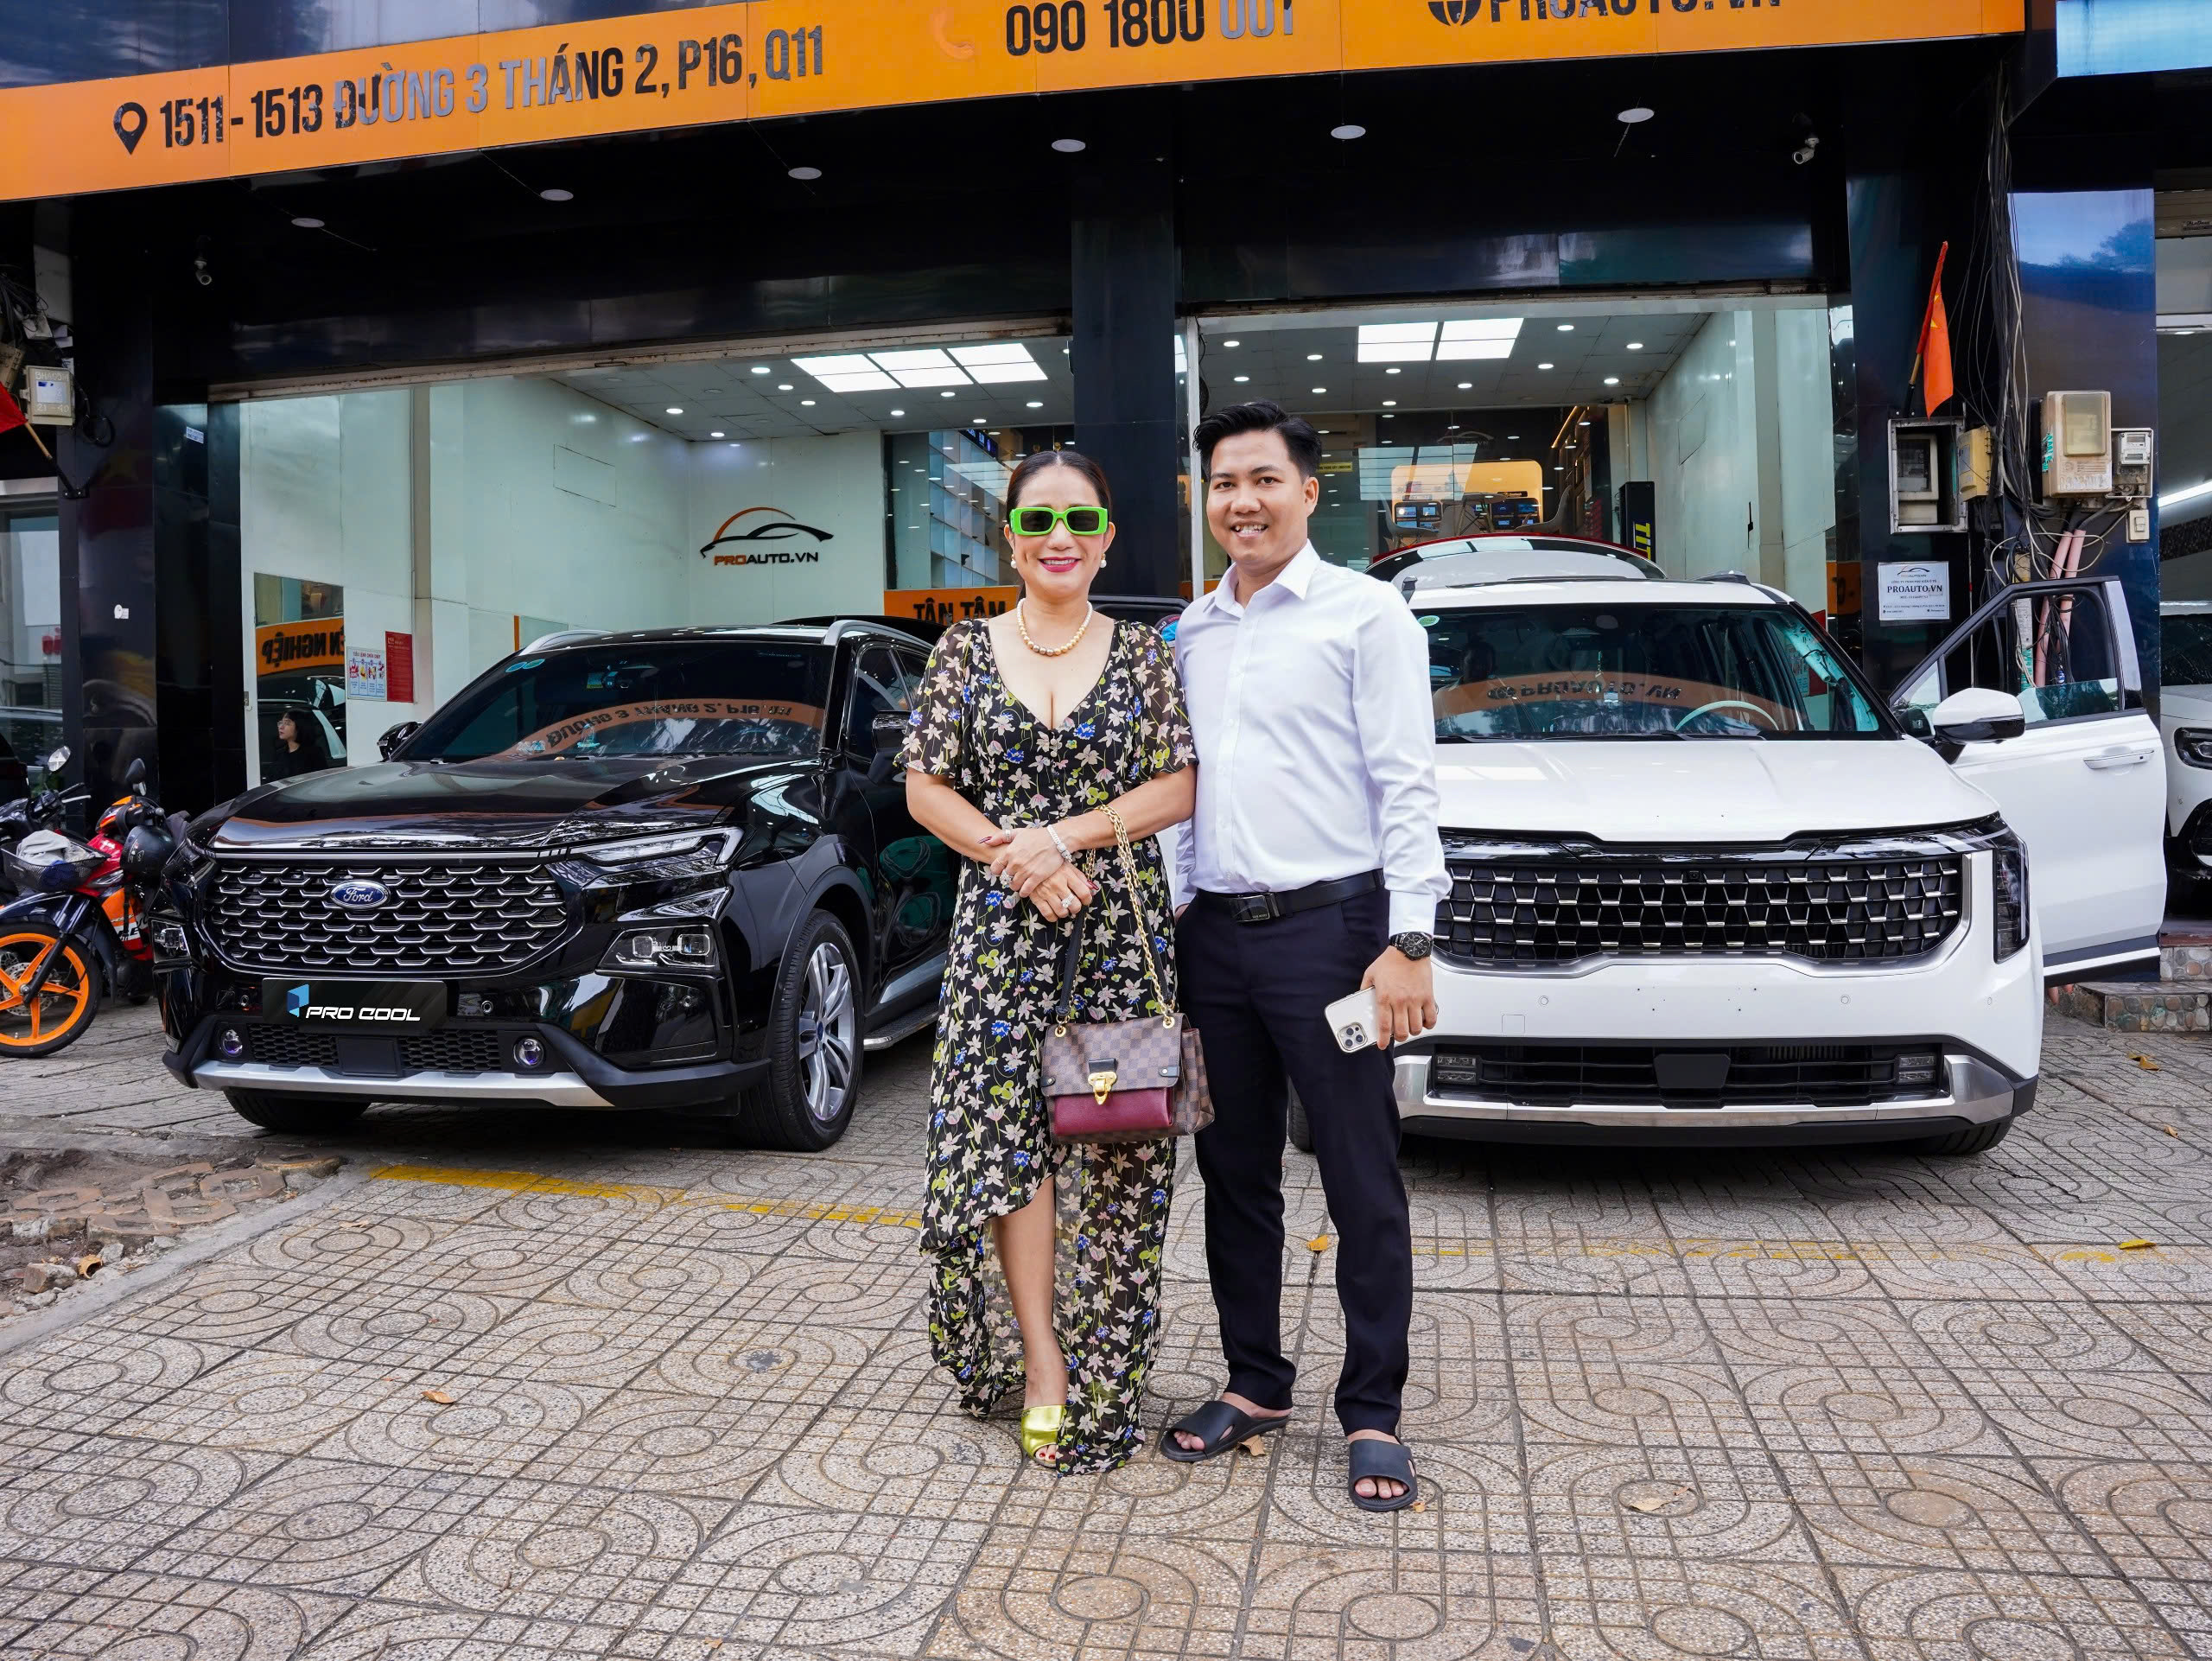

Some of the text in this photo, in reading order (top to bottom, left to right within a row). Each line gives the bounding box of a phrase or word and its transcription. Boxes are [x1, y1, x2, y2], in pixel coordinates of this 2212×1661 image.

[1006, 2, 1086, 56] 090
[1103, 0, 1205, 48] 1800
[333, 62, 455, 130] ĐƯỜNG
[465, 64, 488, 113] 3
[499, 43, 624, 110] THÁNG
[765, 25, 823, 81] Q11
[714, 551, 819, 566] PROAUTO.VN
[343, 887, 373, 902] Ford
[306, 1007, 421, 1021] PRO COOL
